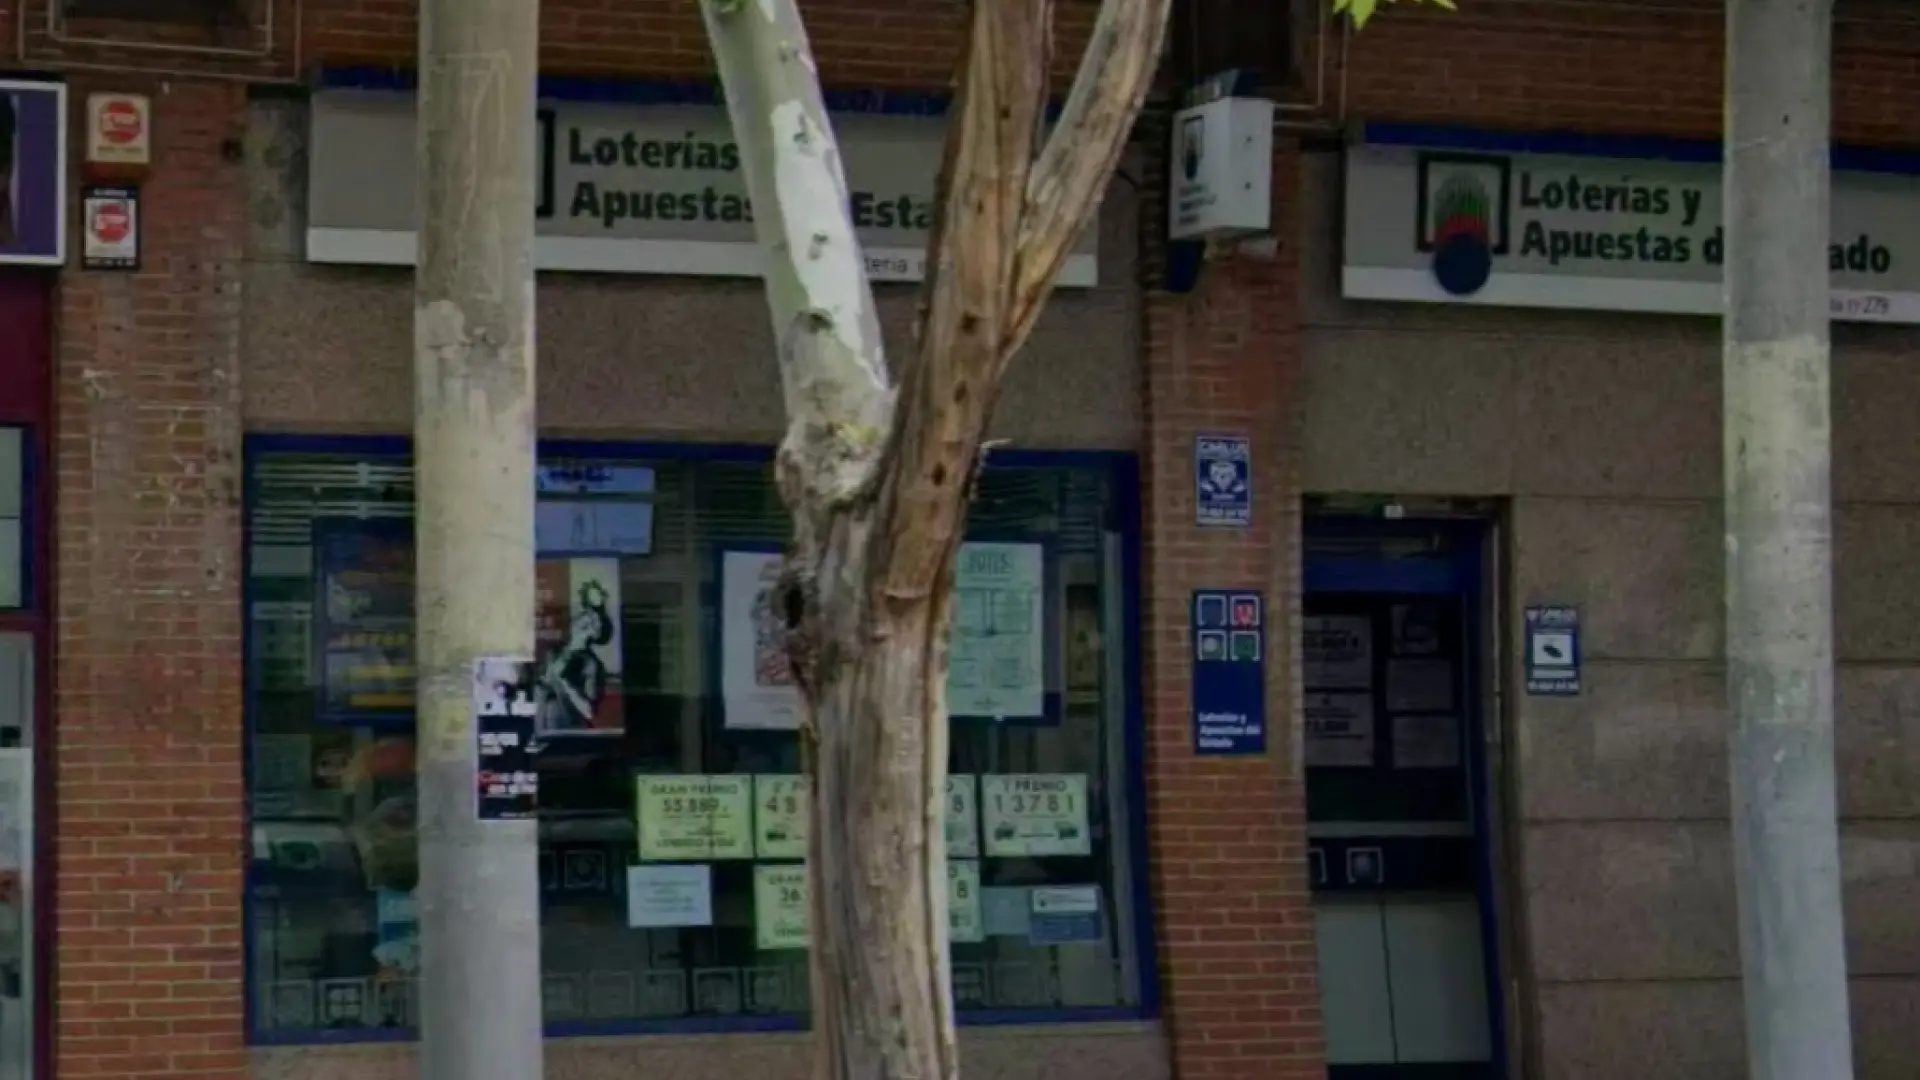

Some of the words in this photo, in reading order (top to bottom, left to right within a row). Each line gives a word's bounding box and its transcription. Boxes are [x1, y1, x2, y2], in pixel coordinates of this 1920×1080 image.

[569, 127, 740, 171] Loterías
[851, 191, 935, 229] Esta
[1519, 172, 1670, 216] Loterías
[1681, 186, 1701, 226] y
[1520, 221, 1691, 264] Apuestas
[1829, 236, 1891, 274] ado
